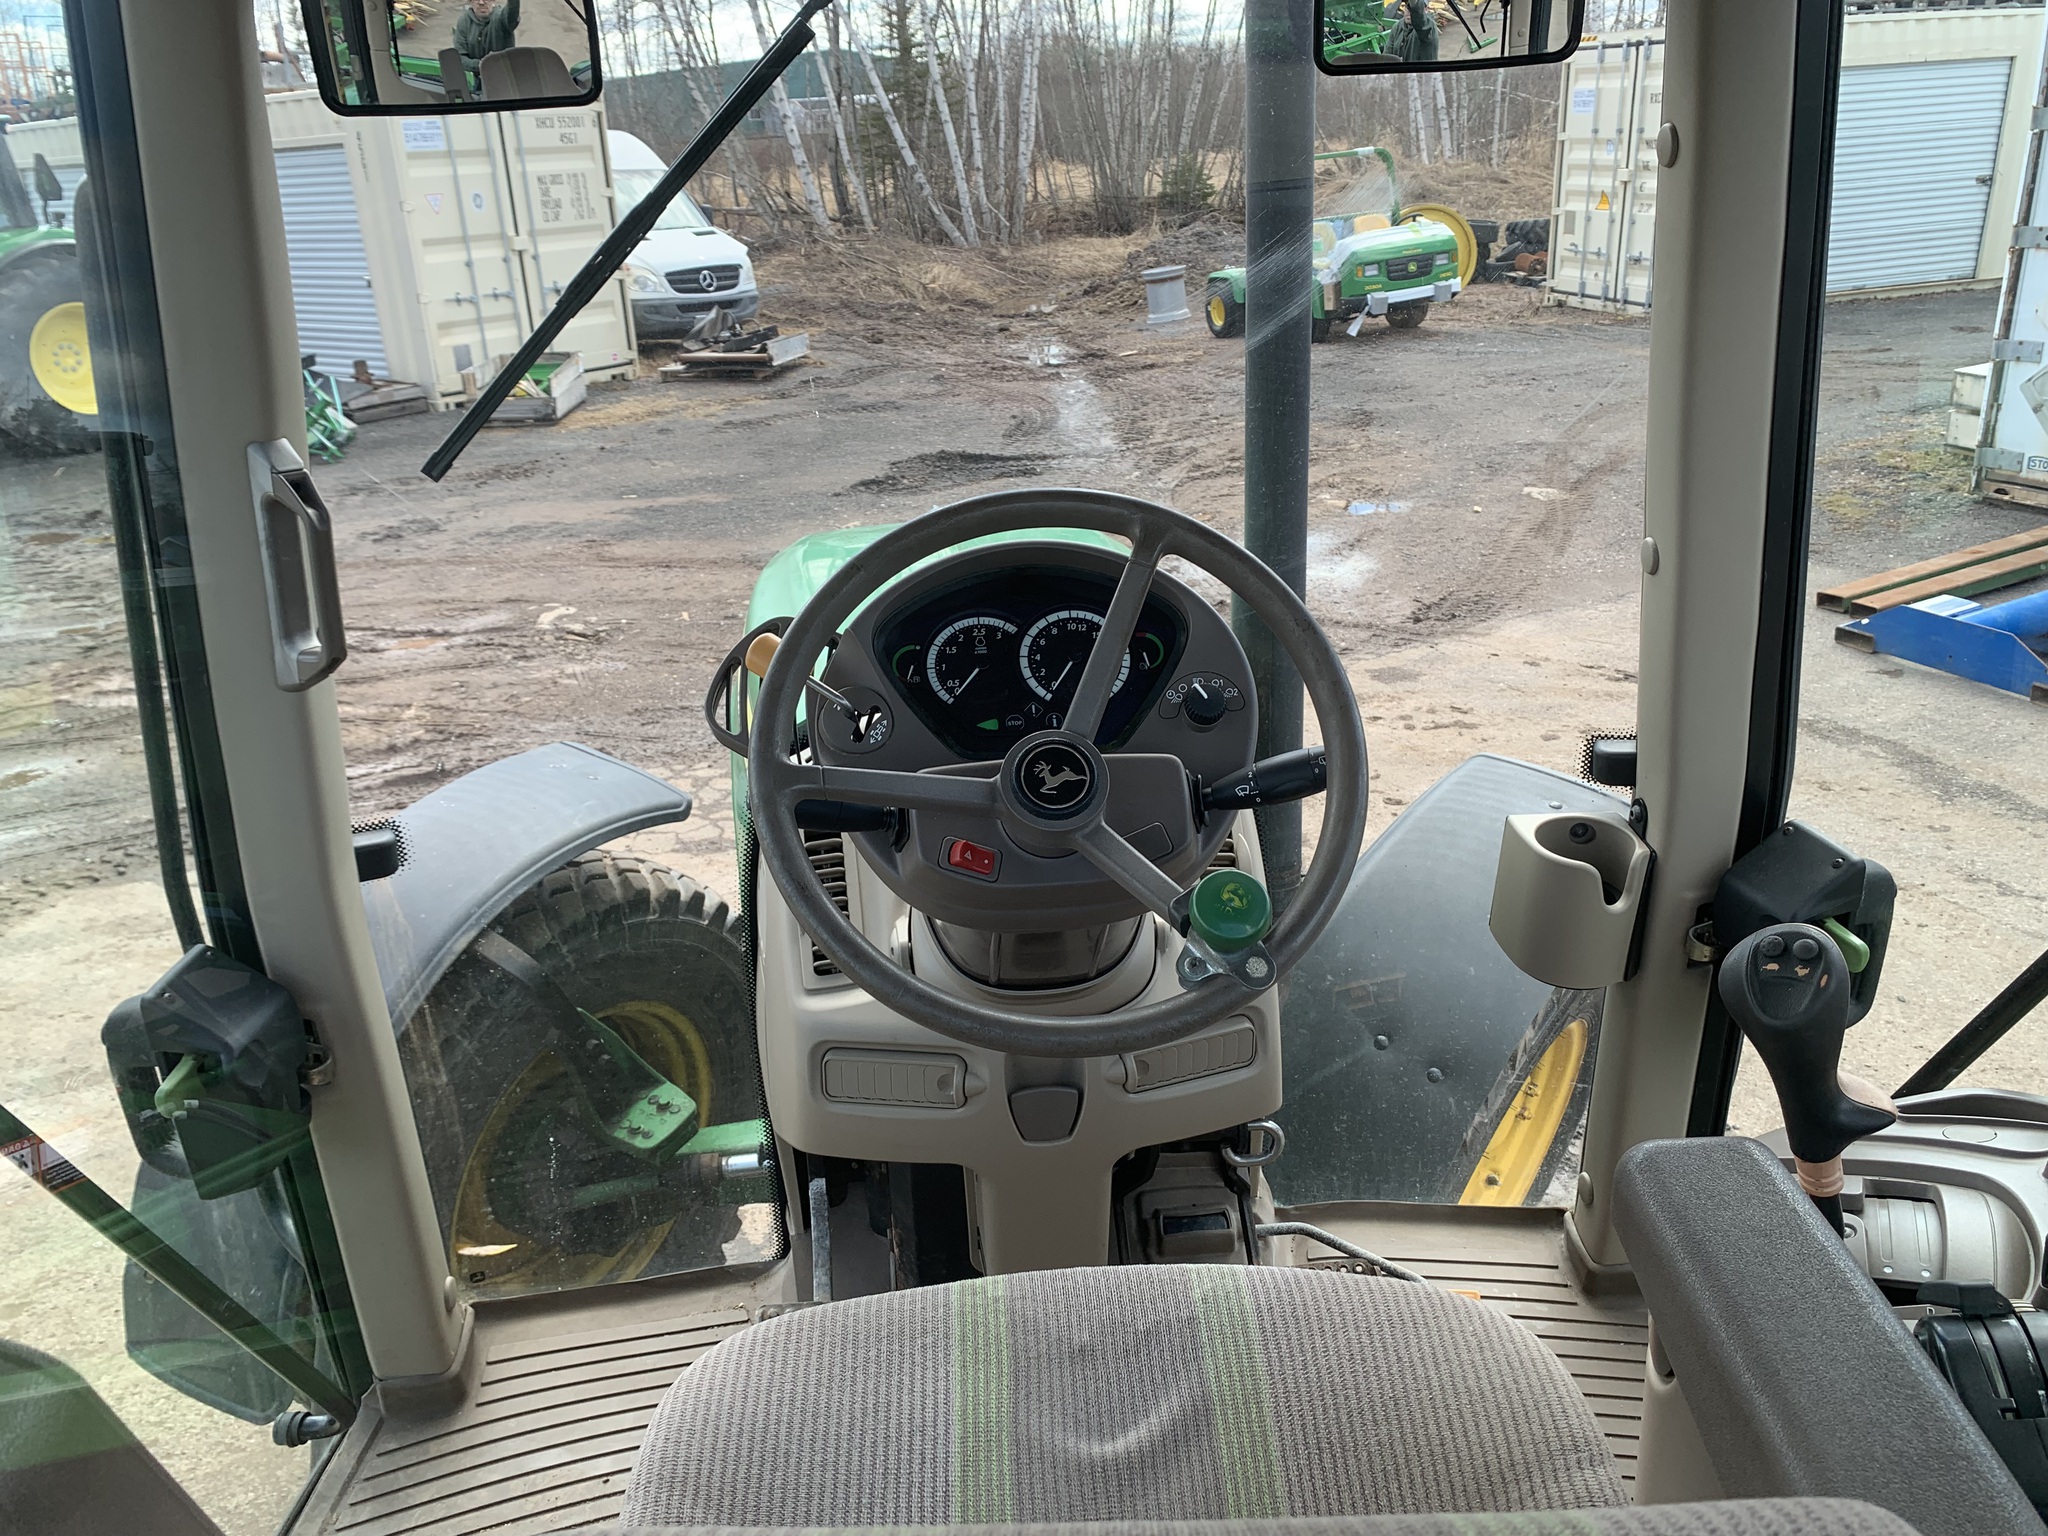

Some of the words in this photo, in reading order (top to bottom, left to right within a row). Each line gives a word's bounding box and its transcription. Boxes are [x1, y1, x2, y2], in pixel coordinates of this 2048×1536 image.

[972, 628, 986, 636] 2.5
[1051, 627, 1058, 635] 8
[996, 632, 1002, 640] 3
[945, 646, 957, 654] 1.5
[947, 679, 960, 687] 0.5
[1233, 688, 1239, 696] 2
